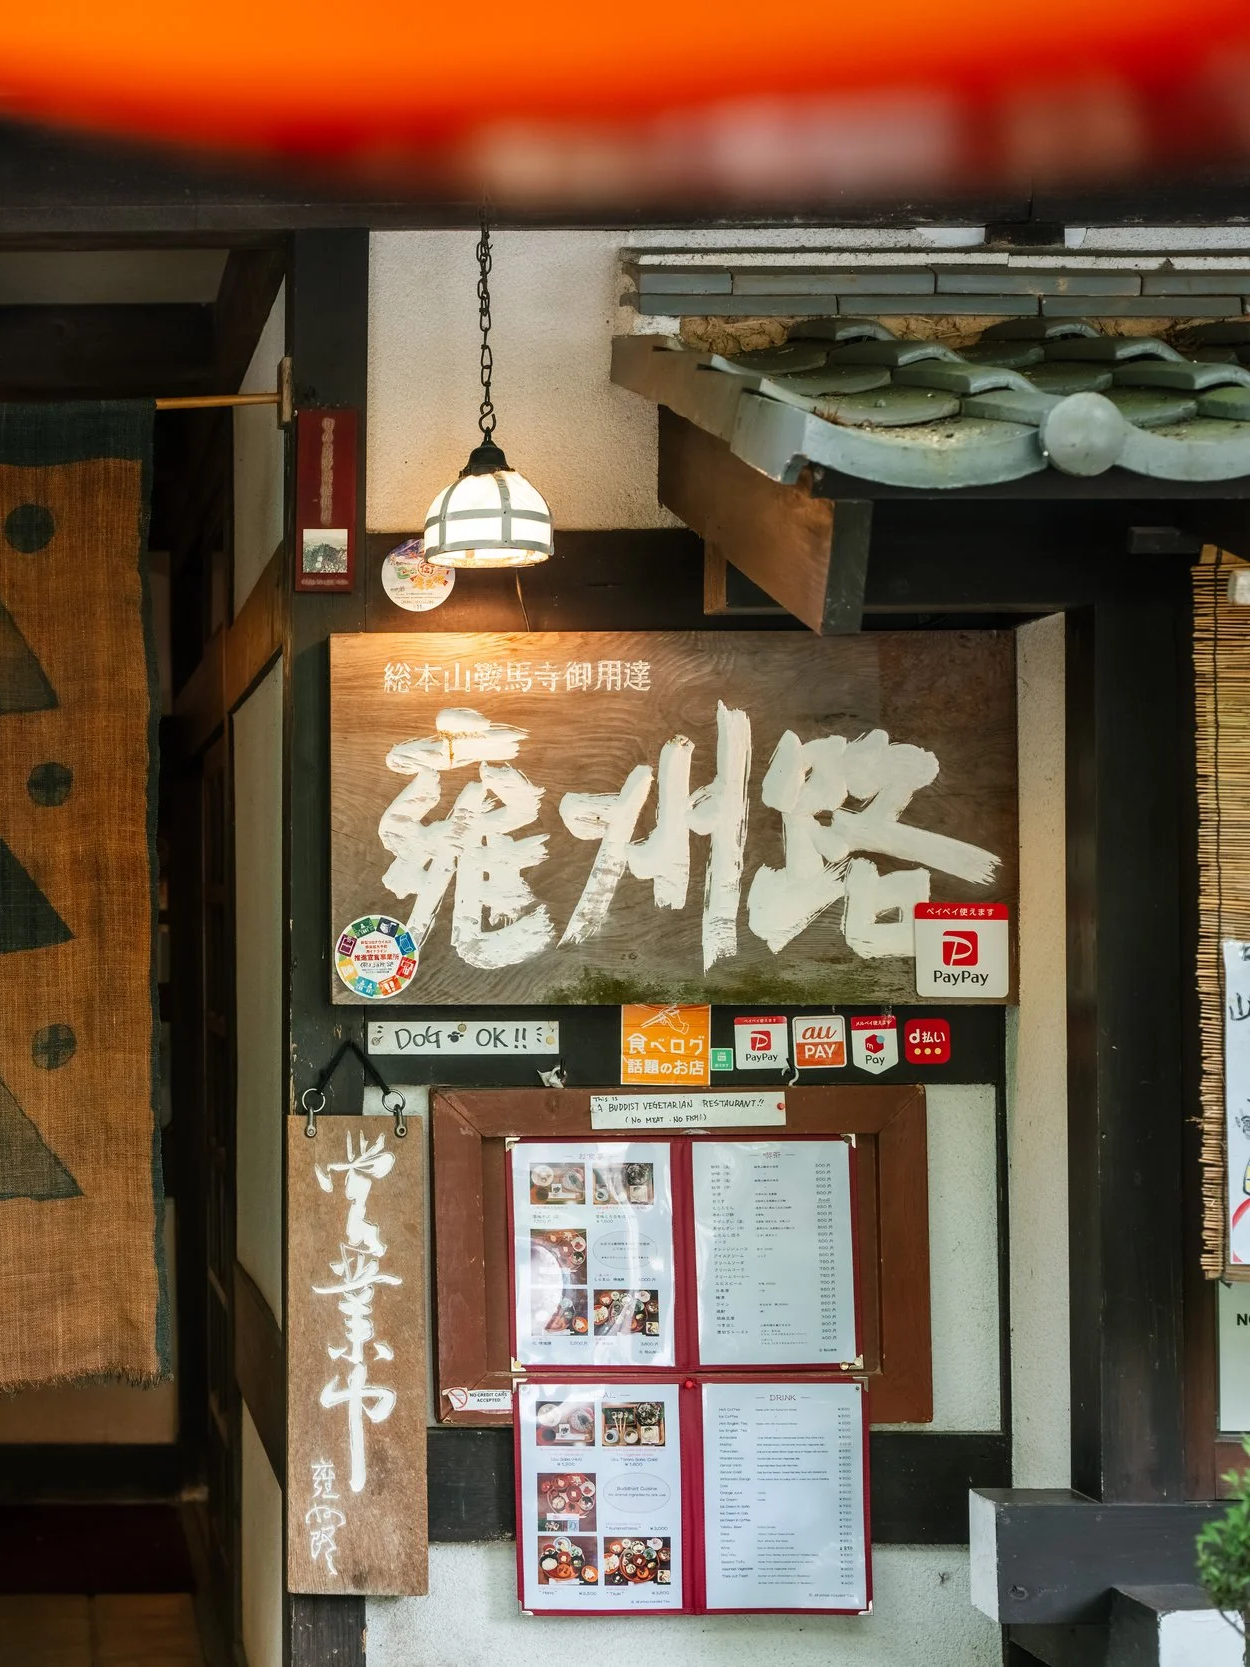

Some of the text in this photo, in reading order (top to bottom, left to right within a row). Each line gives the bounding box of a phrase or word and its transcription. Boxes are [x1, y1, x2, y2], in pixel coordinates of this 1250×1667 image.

[383, 660, 651, 693] 総本山鞍馬寺御用達
[926, 907, 995, 917] ペイペイ使えます
[933, 970, 989, 986] PayPay
[801, 1025, 838, 1040] au
[909, 1028, 946, 1044] d払い
[627, 1032, 705, 1055] 食べログ
[745, 1053, 779, 1063] PayPay
[805, 1044, 836, 1059] PAY
[627, 1059, 705, 1075] 話題のお店
[865, 1055, 885, 1066] Pay
[609, 1102, 639, 1112] BUDDIST
[642, 1100, 693, 1110] VEGETARIAN
